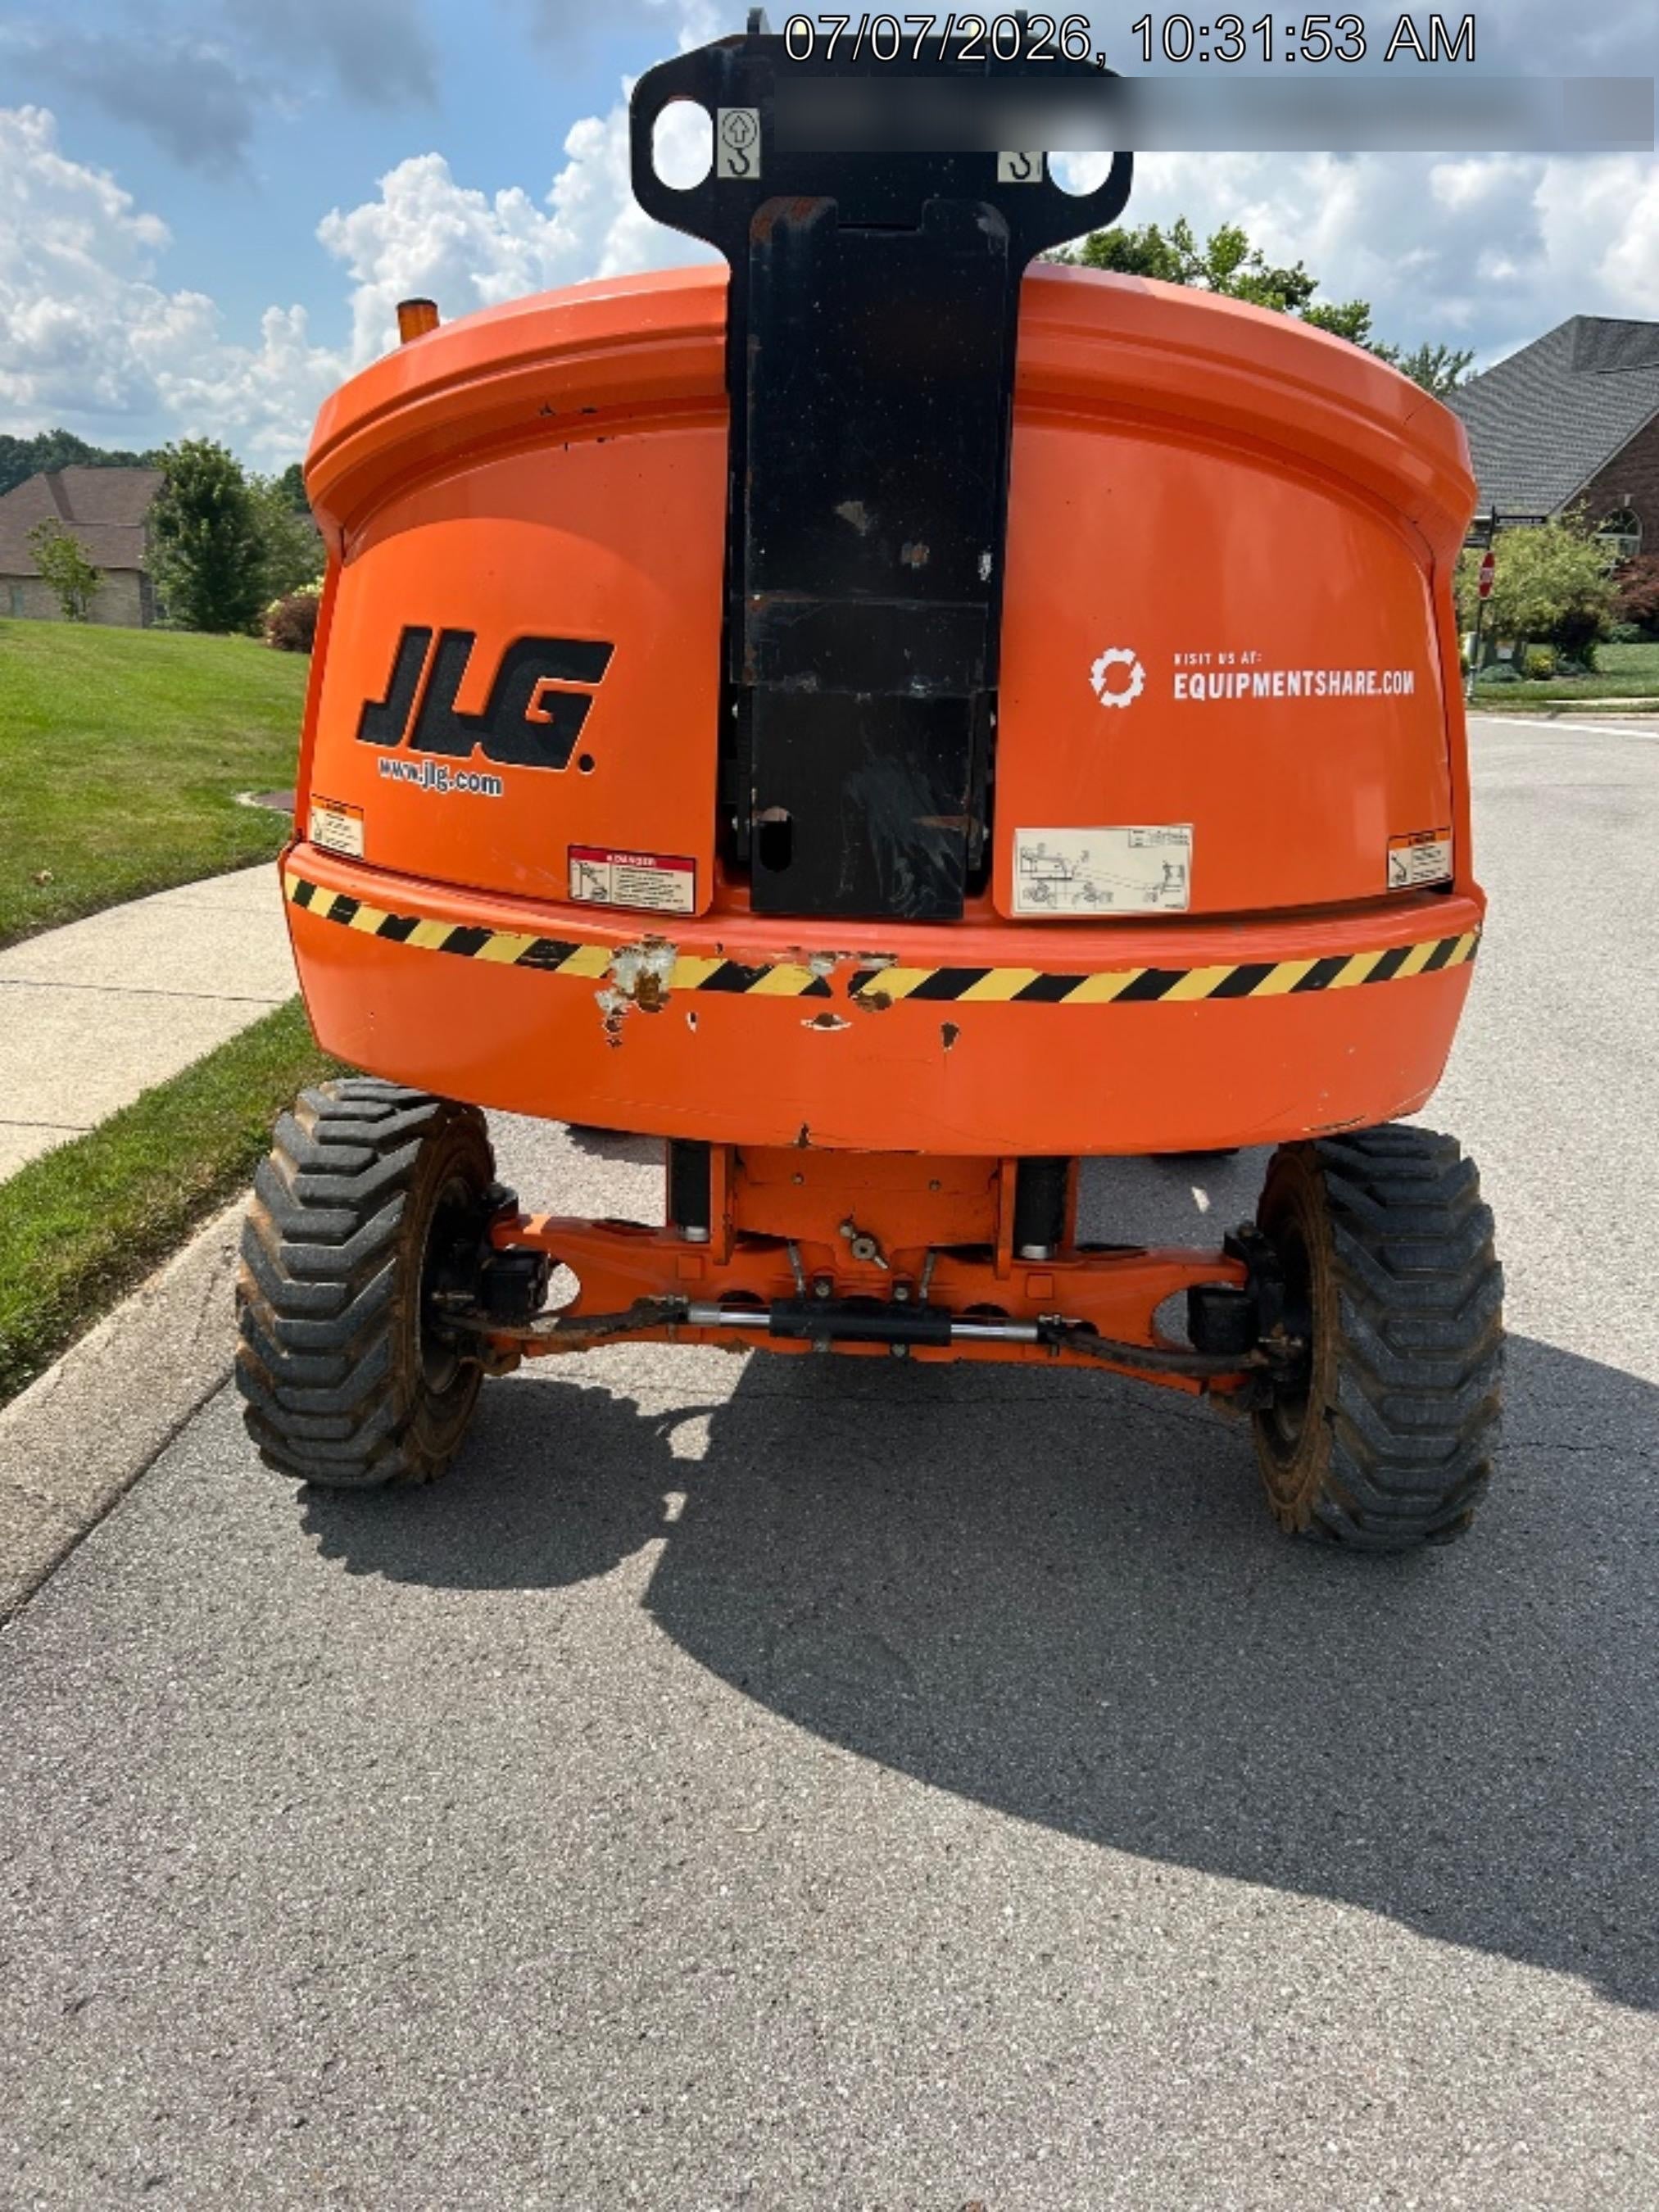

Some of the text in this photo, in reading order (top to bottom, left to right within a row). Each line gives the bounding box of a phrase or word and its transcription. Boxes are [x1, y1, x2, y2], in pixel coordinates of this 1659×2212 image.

[1174, 650, 1262, 665] VISIT US AT:
[1174, 669, 1415, 701] EQUIPMENTSHARE.COM
[378, 757, 503, 796] www.jlg.com
